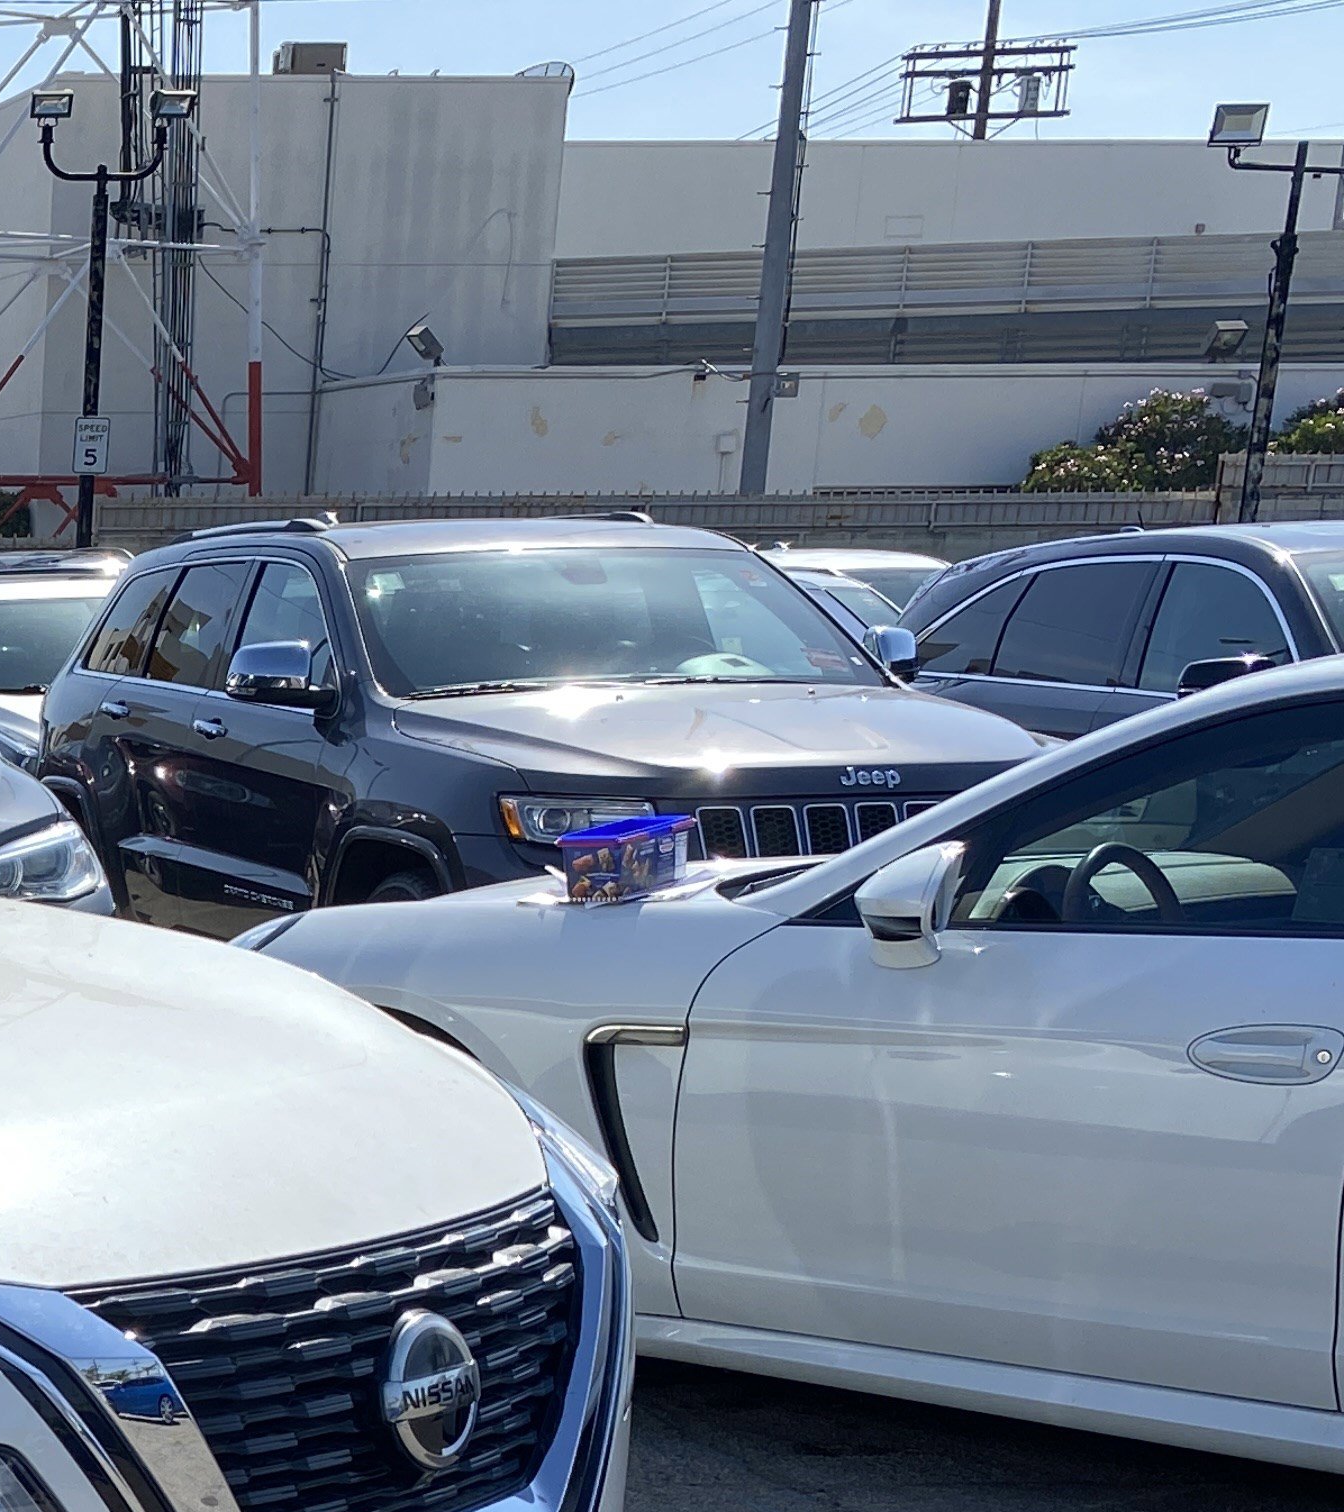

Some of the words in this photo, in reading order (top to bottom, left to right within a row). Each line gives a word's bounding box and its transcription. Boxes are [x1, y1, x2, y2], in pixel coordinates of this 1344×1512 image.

[78, 424, 108, 433] SPEED
[80, 434, 104, 442] LIMIT
[83, 448, 97, 466] 5
[840, 766, 901, 789] Jeep
[401, 1374, 475, 1410] NISSAN
